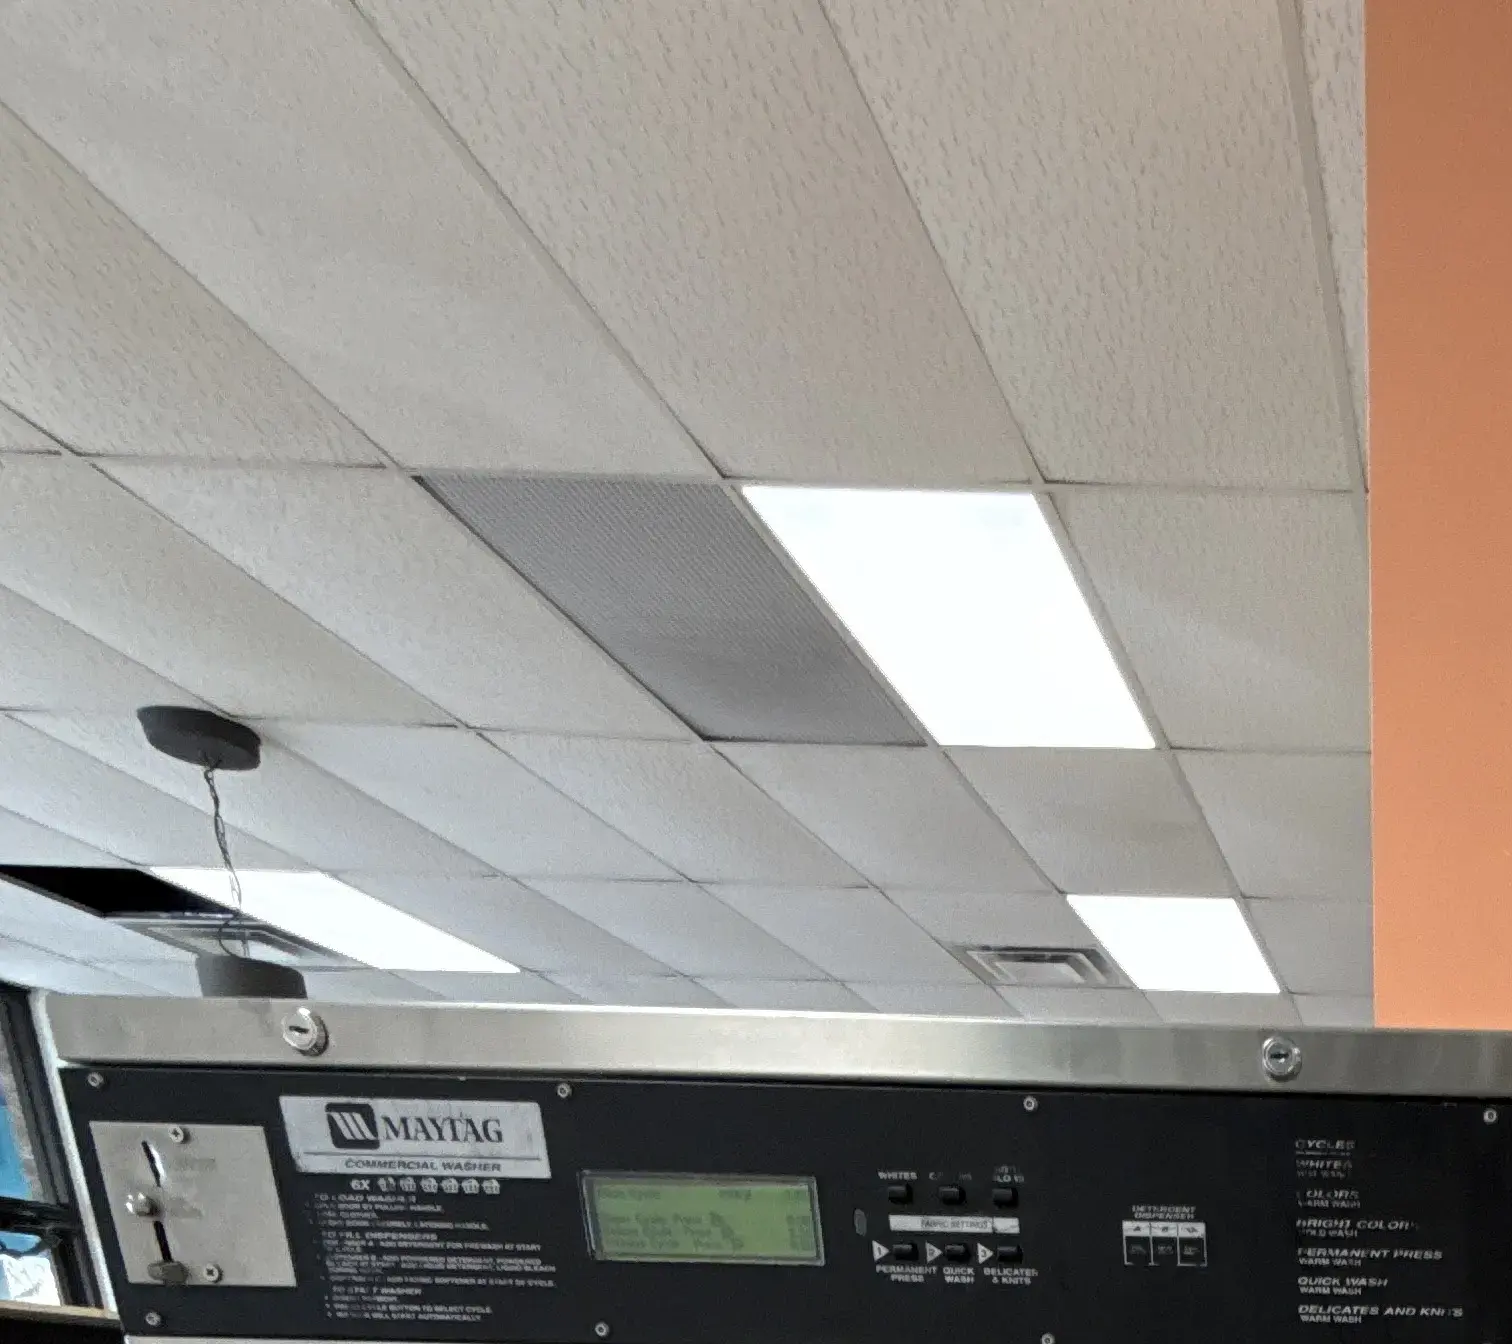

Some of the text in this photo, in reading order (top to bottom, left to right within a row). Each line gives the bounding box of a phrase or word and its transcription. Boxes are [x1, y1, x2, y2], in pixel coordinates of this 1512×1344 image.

[382, 1115, 503, 1143] MAYTAG
[1295, 1139, 1356, 1149] CYCLES
[344, 1159, 502, 1172] COMMERCIAL WASHER
[877, 1171, 918, 1180] WHITES
[350, 1178, 371, 1191] 6X
[1296, 1190, 1360, 1200] OLORS
[1298, 1248, 1444, 1260] PERMANENT PRESS
[1299, 1258, 1330, 1266] WARM
[875, 1265, 938, 1275] PERMANENT
[942, 1266, 975, 1275] QUICK
[890, 1274, 925, 1283] PRESS
[944, 1275, 975, 1284] WASH
[1001, 1276, 1032, 1285] KNITS
[1298, 1276, 1389, 1287] QUICK WASH
[1299, 1287, 1362, 1296] WARM WASH
[1298, 1304, 1416, 1316] DELICATES AND
[1300, 1315, 1362, 1324] WARM WASH
